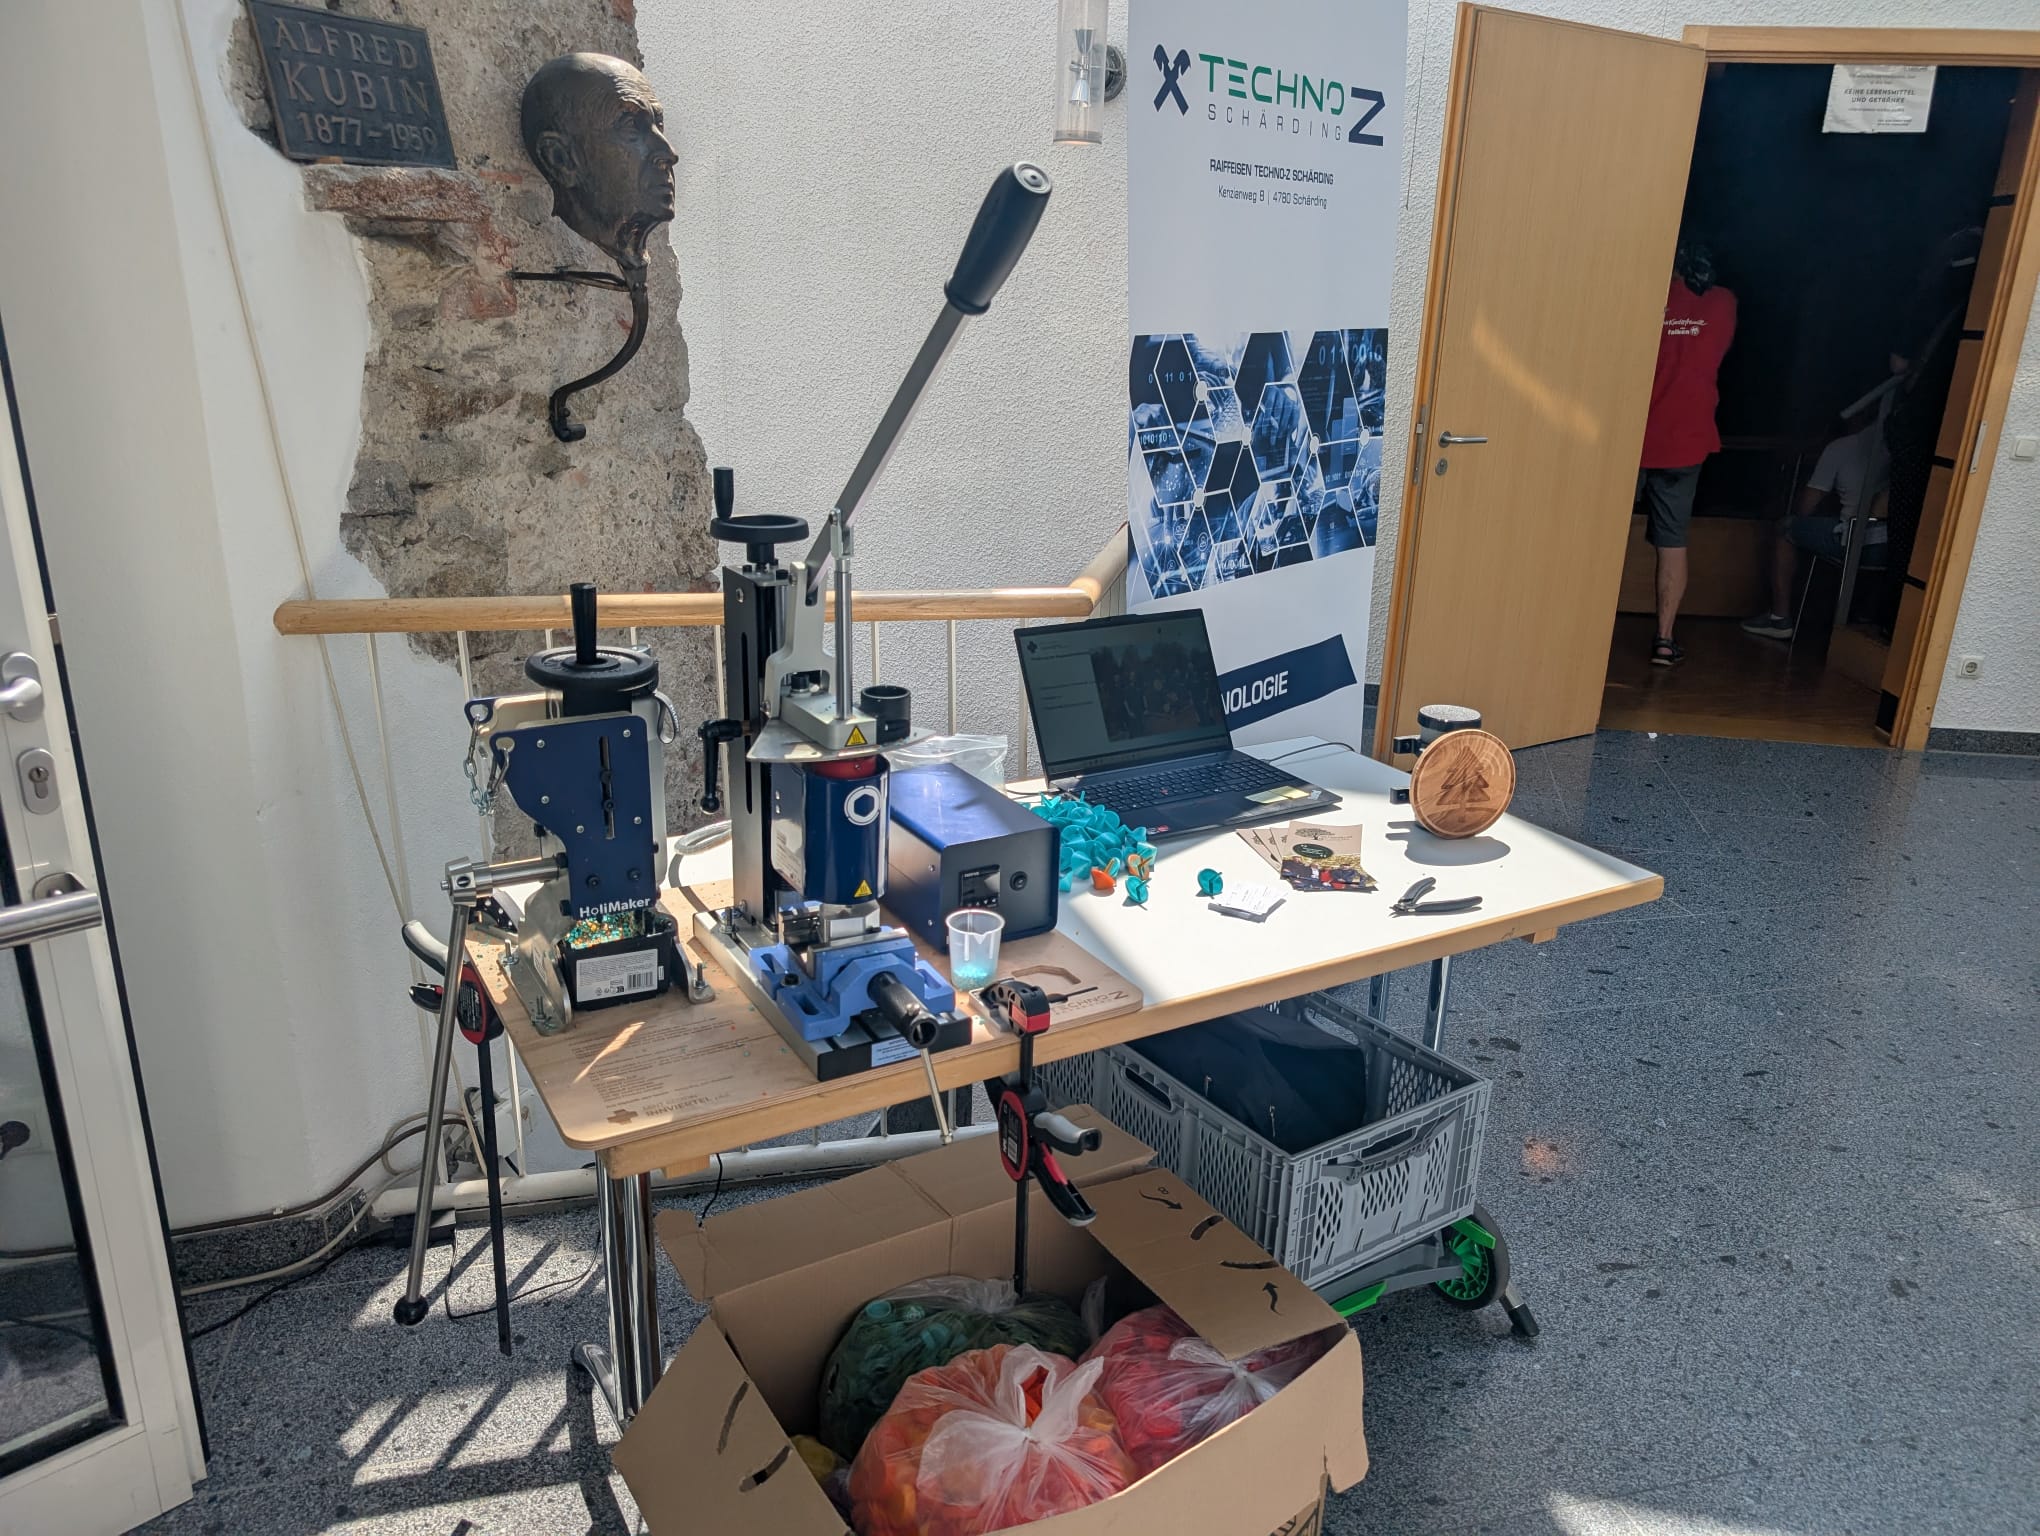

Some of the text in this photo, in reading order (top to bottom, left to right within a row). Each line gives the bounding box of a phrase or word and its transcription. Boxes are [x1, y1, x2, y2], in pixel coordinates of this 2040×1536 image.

[273, 16, 418, 71] ALFRED
[278, 60, 432, 119] KUBIN
[1207, 103, 1342, 141] SCHÄRDING
[1209, 158, 1334, 185] RAIFFEISEN TECHNO-Z SCHÄRDING
[1272, 191, 1291, 204] 4780
[579, 897, 652, 919] HoliMaker
